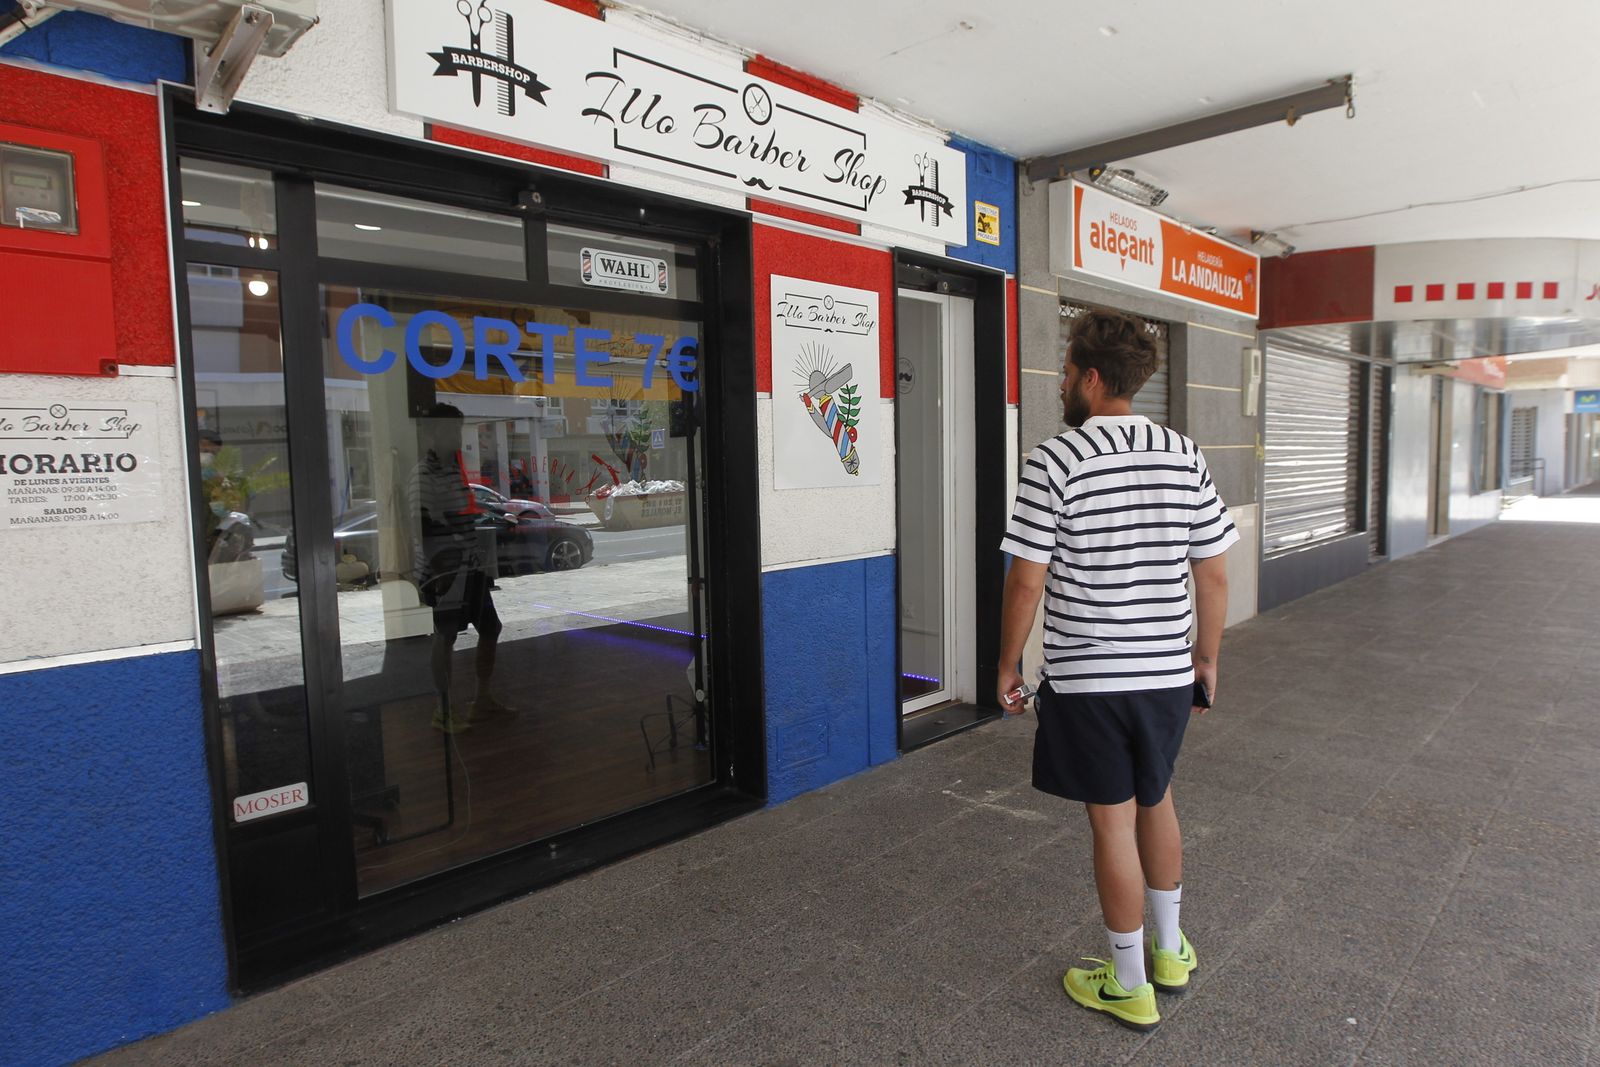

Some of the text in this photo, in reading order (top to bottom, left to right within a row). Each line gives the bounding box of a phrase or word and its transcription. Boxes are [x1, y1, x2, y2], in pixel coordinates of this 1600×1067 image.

[451, 52, 531, 84] BARBERSHOP
[581, 71, 888, 206] Illo Barber Shop
[1109, 211, 1138, 232] HELADOS
[600, 257, 650, 279] WAHL
[1171, 257, 1244, 301] LA ANDALUZA
[807, 305, 847, 325] Barber
[851, 312, 876, 332] Shop
[336, 303, 699, 392] CORTE 7€
[22, 415, 91, 433] Barber
[100, 416, 142, 436] Shop
[28, 477, 60, 486] LUNES
[69, 476, 110, 485] VIERNES
[61, 485, 86, 494] 09:30
[94, 484, 118, 493] 14:00
[8, 495, 48, 505] TARDES:
[63, 494, 86, 502] 17:00
[43, 506, 87, 516] SABADOS
[63, 514, 88, 523] 09:30
[97, 512, 120, 521] 14:00
[236, 788, 304, 817] MOSER
